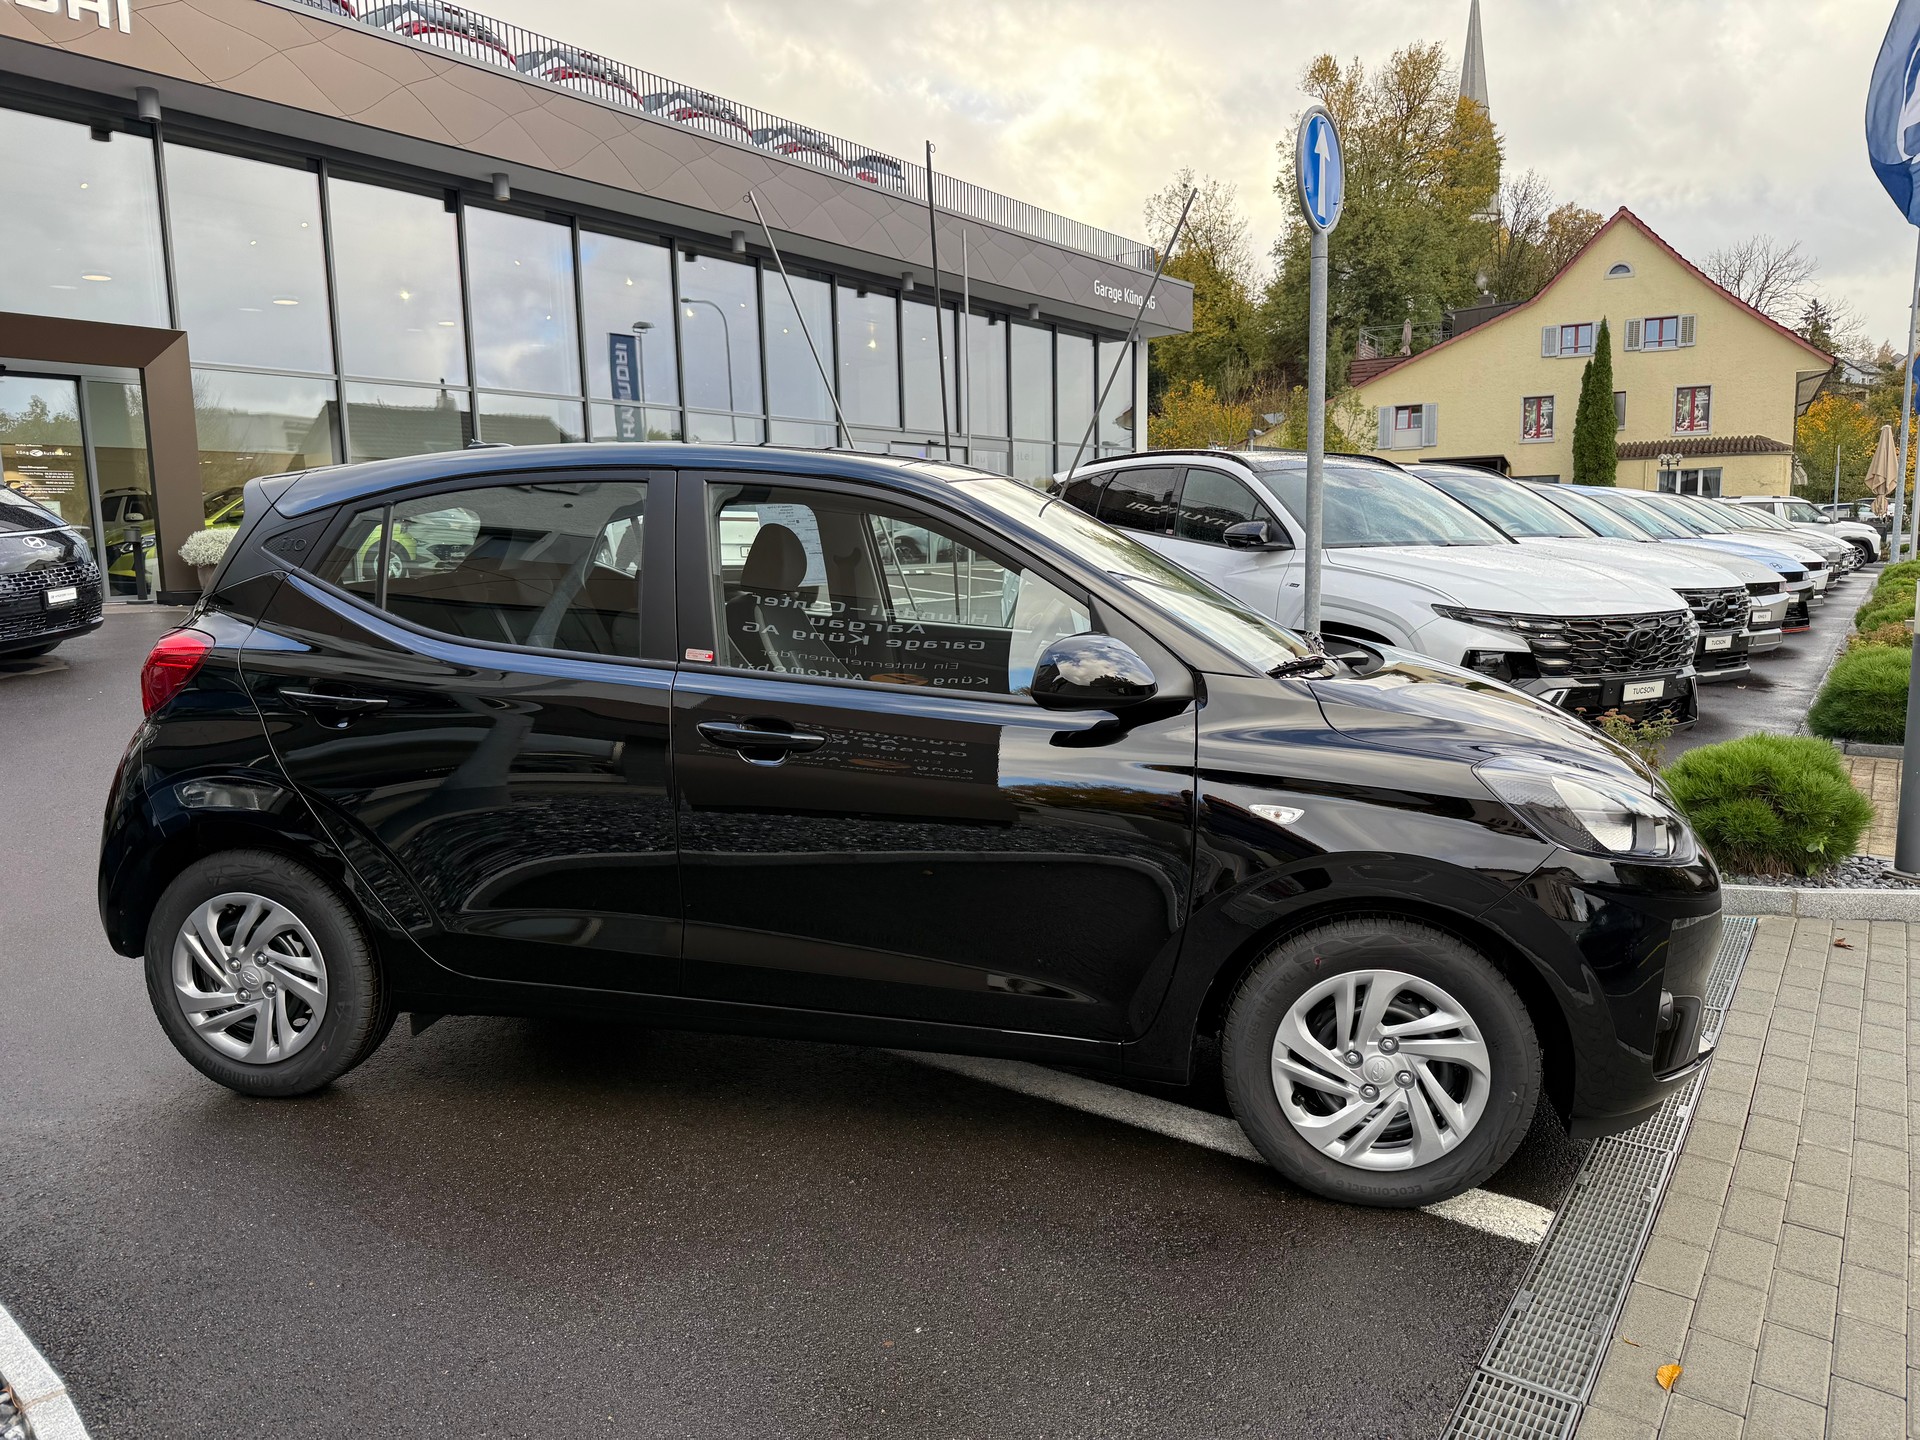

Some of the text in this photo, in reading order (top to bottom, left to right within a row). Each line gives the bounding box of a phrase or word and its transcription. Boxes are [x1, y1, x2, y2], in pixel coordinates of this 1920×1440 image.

[1094, 279, 1155, 310] Garage Küng AG
[1633, 685, 1656, 695] TUCSON
[1335, 1179, 1424, 1198] EcoContact 6
